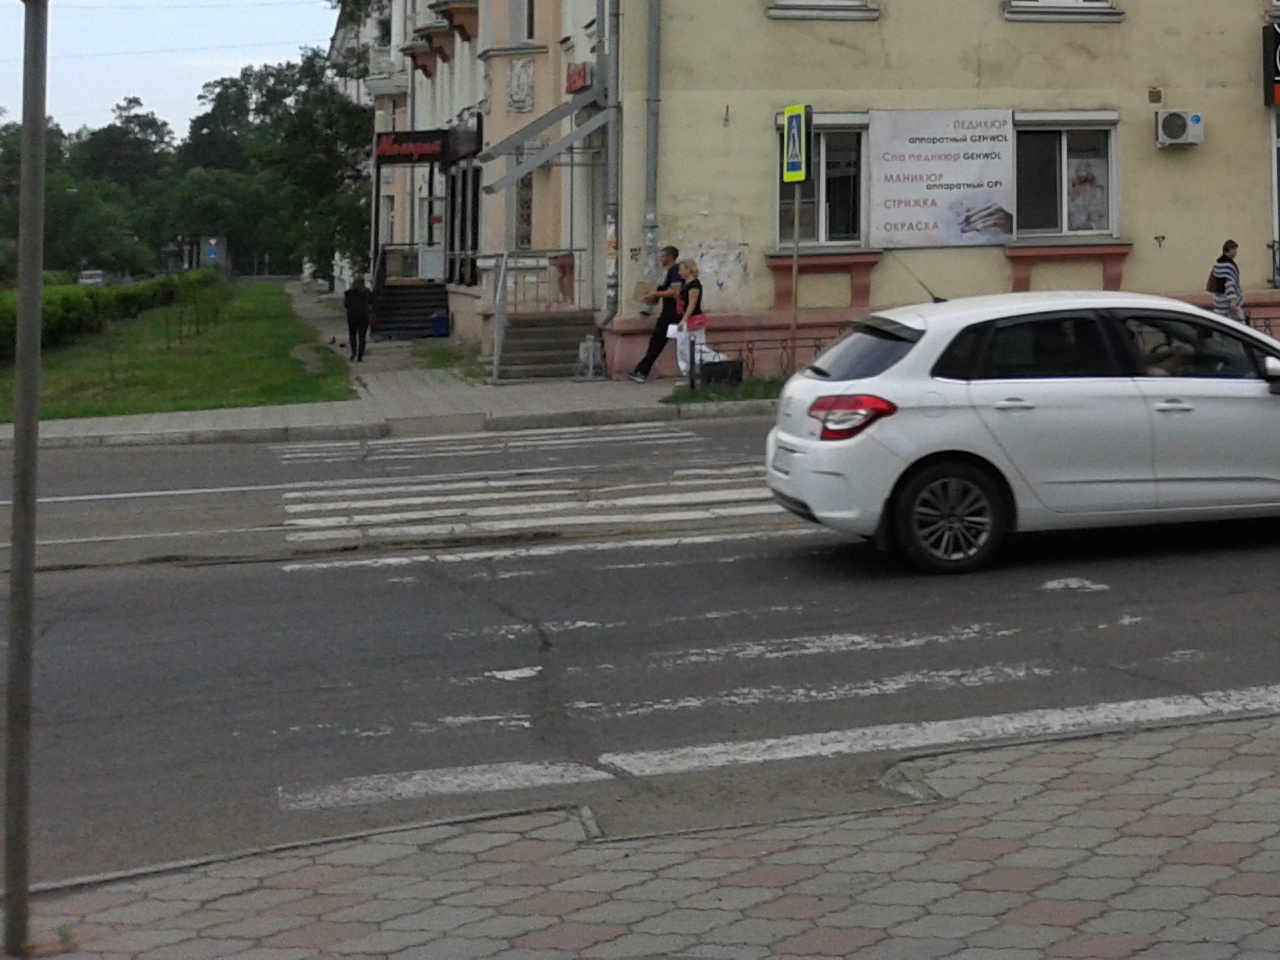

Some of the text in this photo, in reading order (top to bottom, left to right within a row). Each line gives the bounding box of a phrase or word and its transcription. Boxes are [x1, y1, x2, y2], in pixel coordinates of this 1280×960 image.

[953, 119, 1008, 131] ПЕДИКЮР
[908, 134, 967, 144] аппаратный
[909, 152, 960, 162] педикюр
[883, 173, 944, 183] МАНИКЮР
[926, 181, 984, 190] аппаратный
[883, 198, 938, 209] СТРИЖКА
[883, 221, 939, 232] ОКРАСКА
